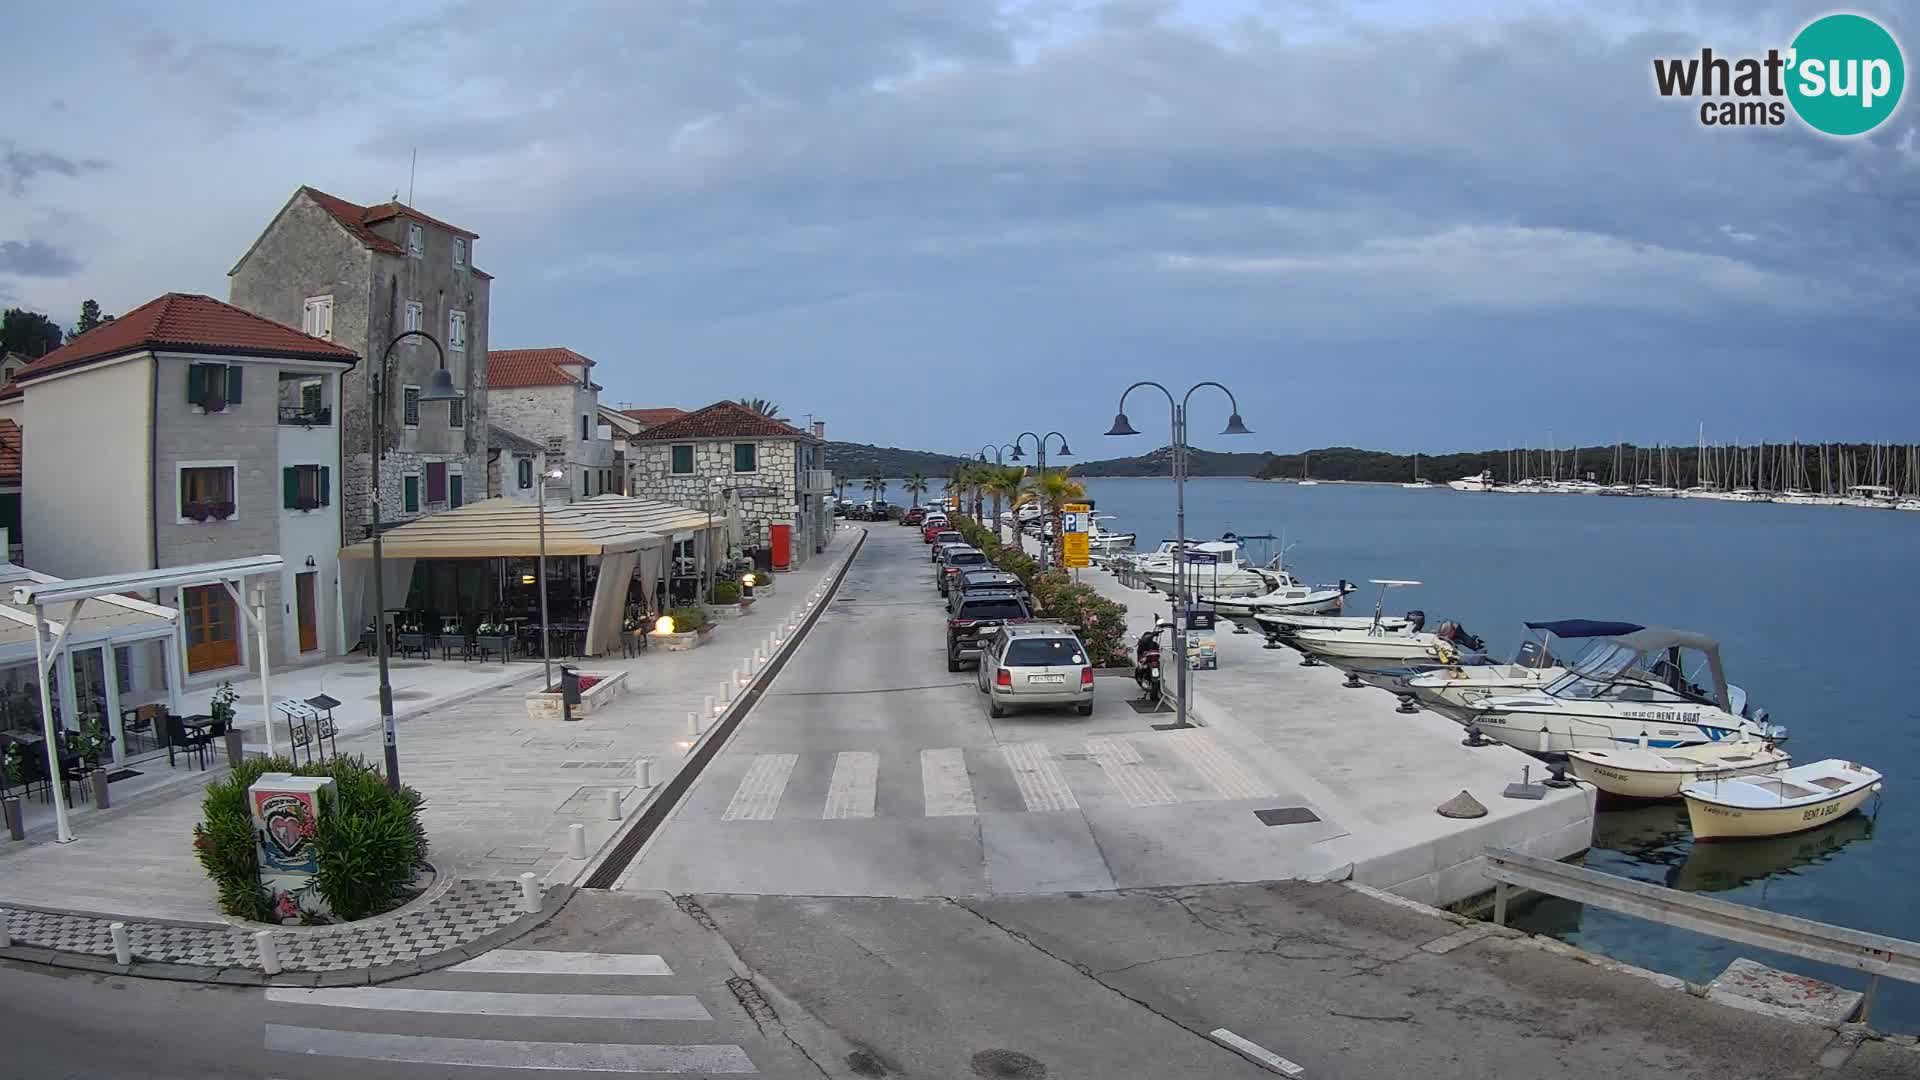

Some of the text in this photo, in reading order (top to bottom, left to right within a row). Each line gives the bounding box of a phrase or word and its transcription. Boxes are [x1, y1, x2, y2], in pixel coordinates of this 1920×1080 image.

[1065, 514, 1076, 531] P
[1656, 711, 1675, 721] RENT
[1676, 712, 1681, 721] A
[1682, 712, 1701, 723] BOAT
[1802, 807, 1820, 821] RENT
[1825, 802, 1841, 817] BOAT
